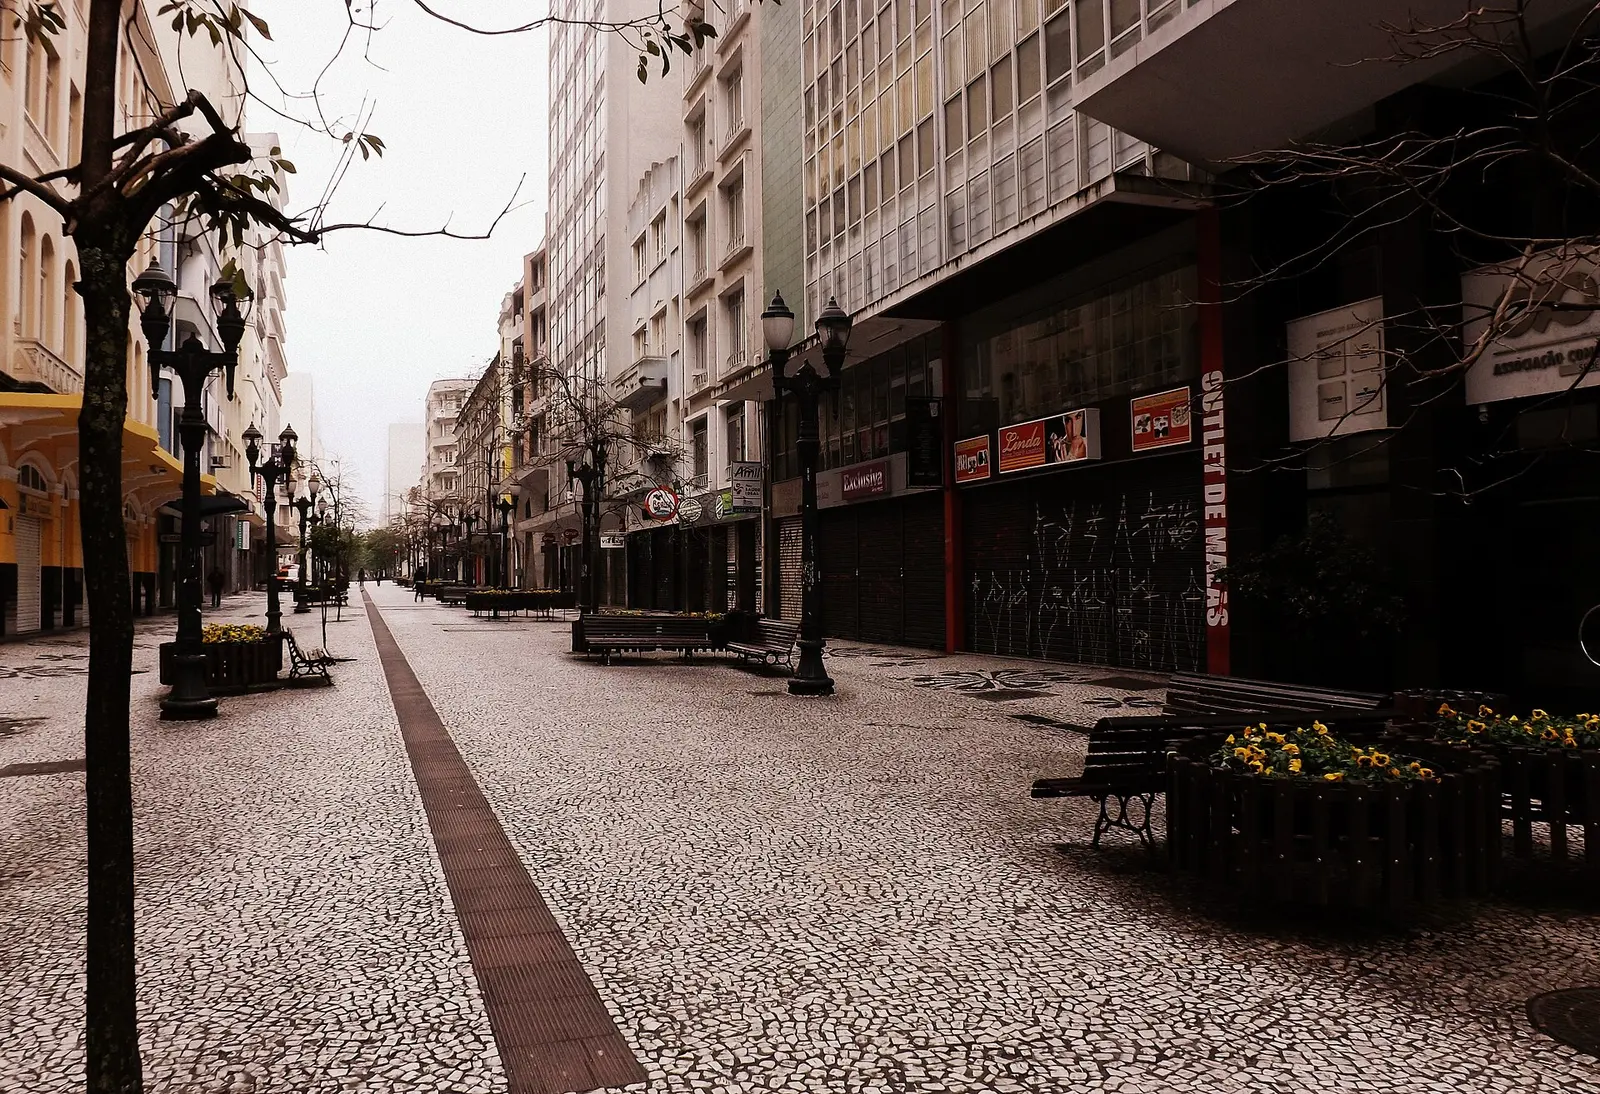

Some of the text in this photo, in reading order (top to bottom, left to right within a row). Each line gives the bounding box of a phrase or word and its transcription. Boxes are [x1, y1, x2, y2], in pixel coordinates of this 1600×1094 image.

[1493, 343, 1600, 375] ASSOCIAÇÃO COM
[1002, 426, 1041, 453] Linda
[843, 469, 883, 491] Exclusiva
[1201, 370, 1228, 627] OUTLET DE MALAS
